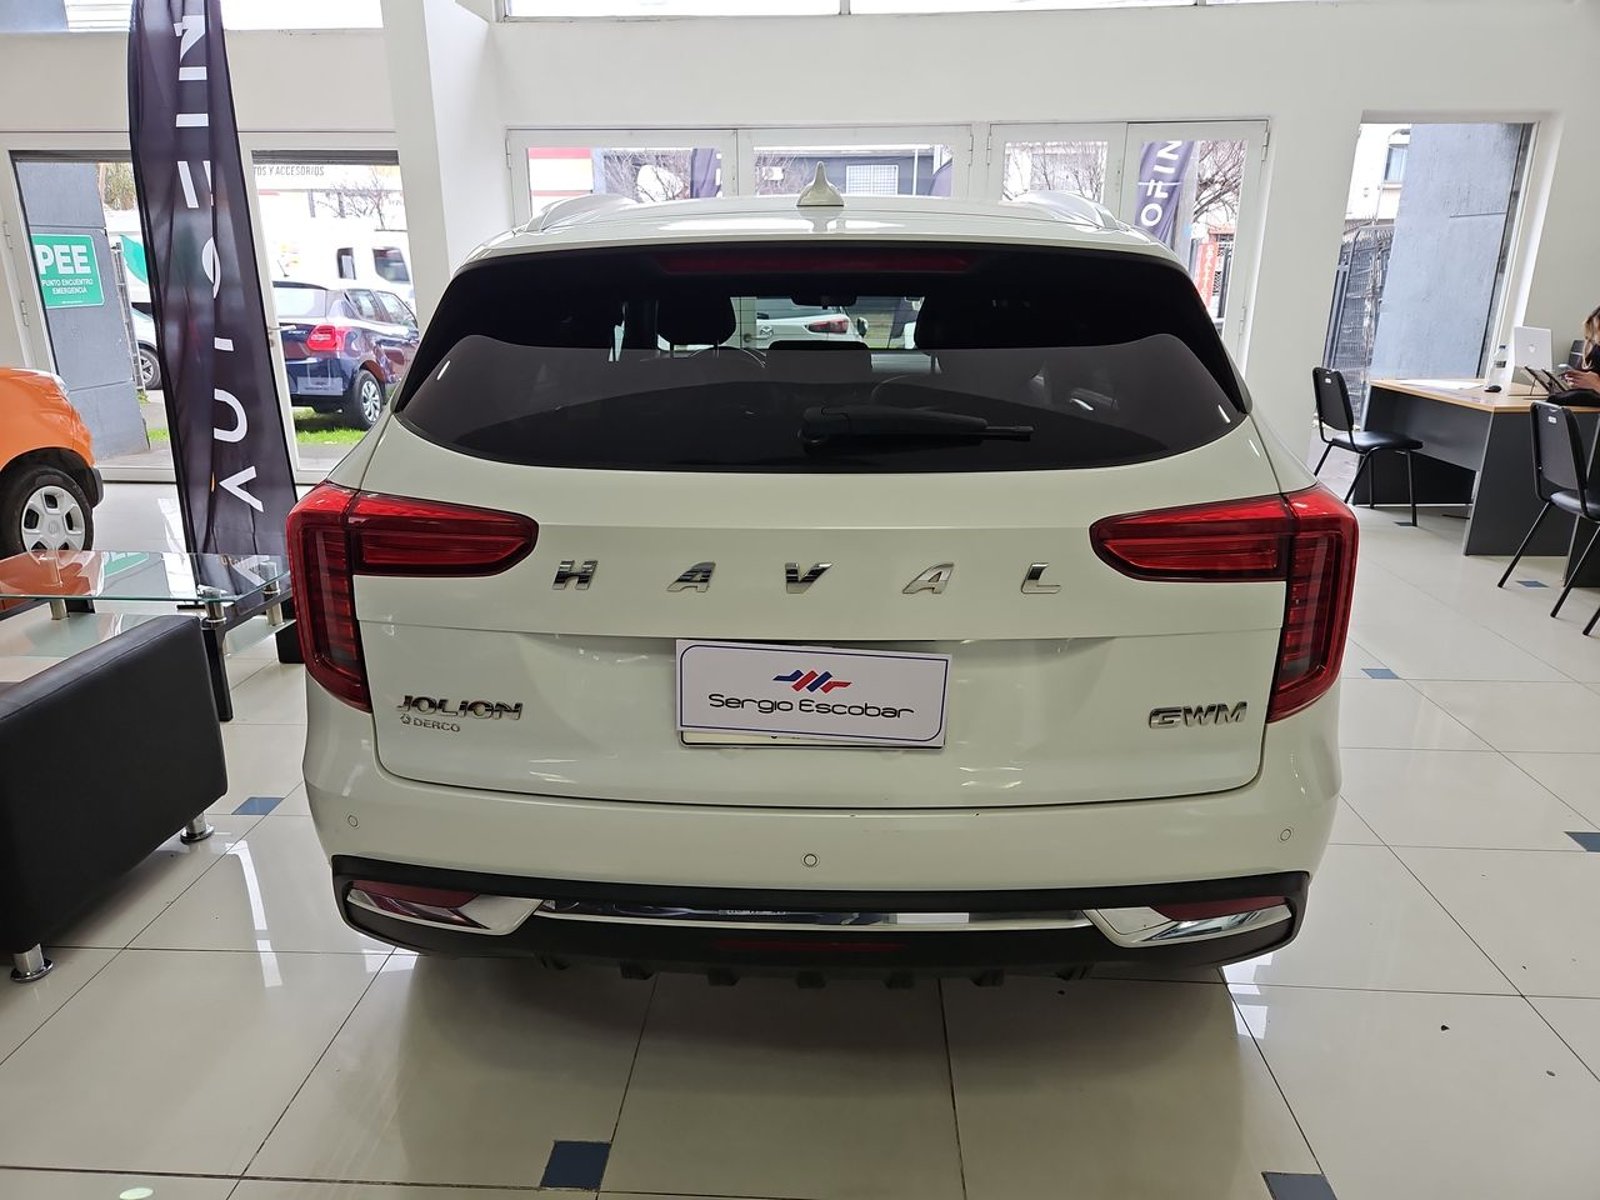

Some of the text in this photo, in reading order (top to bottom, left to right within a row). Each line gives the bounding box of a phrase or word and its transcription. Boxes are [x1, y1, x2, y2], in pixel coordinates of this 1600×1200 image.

[269, 165, 275, 176] Y
[275, 165, 325, 176] ACCESORIOS
[34, 244, 92, 275] PEE
[41, 278, 94, 287] PUNTO ENCUENTRO
[52, 286, 88, 295] EMERGENCIA
[551, 560, 1062, 595] HAVAL
[396, 694, 523, 720] JOLION
[708, 693, 915, 719] Sergio Escobar
[1148, 701, 1248, 729] GWM
[413, 717, 461, 732] DERCO
